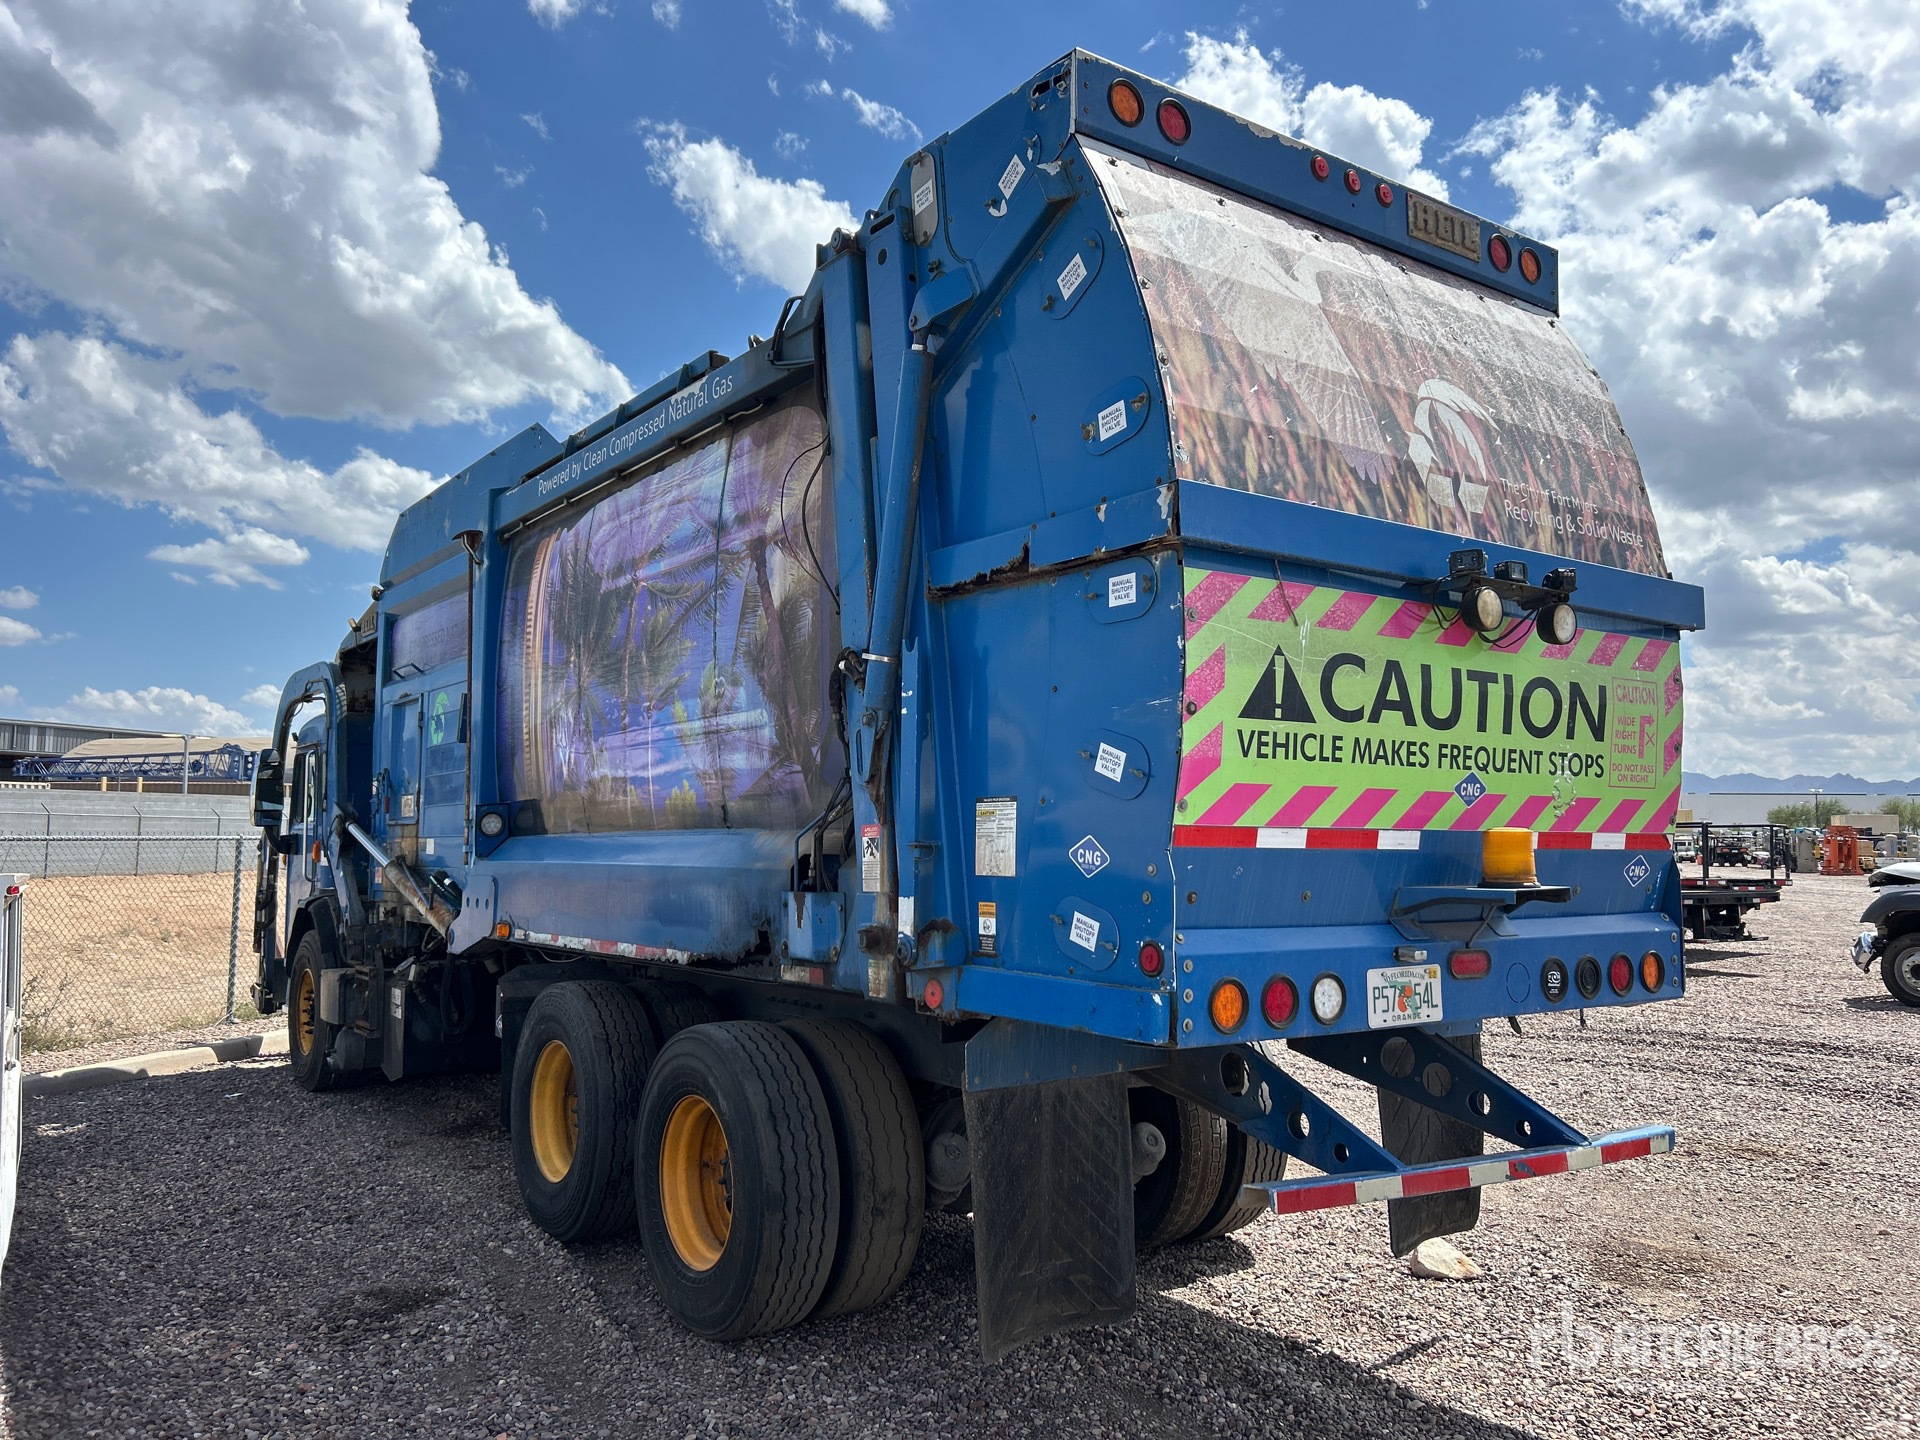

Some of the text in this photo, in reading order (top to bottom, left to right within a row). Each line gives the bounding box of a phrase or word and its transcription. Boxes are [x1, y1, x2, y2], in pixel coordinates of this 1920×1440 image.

[1060, 261, 1078, 283] MANUAL
[1062, 264, 1081, 289] SHUTOFF
[1067, 273, 1081, 290] VALVE
[1101, 406, 1122, 421] MANUAL
[1101, 412, 1123, 428] SHUTOFF
[1105, 420, 1121, 433] VALVE
[538, 375, 733, 497] Powered by Clean Compressed Natural Gas
[1500, 478, 1598, 514] The City of Fort Myers
[1504, 500, 1643, 547] Recycling & Solid Waste
[1111, 578, 1132, 588] MANUAL
[1111, 585, 1133, 594] SHUTOFF
[1114, 592, 1130, 600] VALVE
[1320, 653, 1607, 742] CAUTION
[1616, 684, 1656, 706] CAUTION
[1617, 716, 1635, 726] WIDE
[1615, 730, 1636, 740] RIGHT
[1102, 748, 1121, 761] MANUAL
[1237, 729, 1605, 778] VEHICLE MAKES FREQUENT STOPS
[1613, 744, 1636, 754] TURNS
[1100, 755, 1121, 768] SHUTOFF
[1101, 763, 1117, 774] VALVE
[1612, 763, 1654, 774] DO NOT PASS
[1617, 774, 1649, 783] ON RIGHT
[1460, 783, 1480, 797] CNG
[1077, 848, 1101, 866] CNG
[1629, 865, 1646, 877] CNG
[1076, 917, 1095, 931] MANUAL
[1074, 924, 1095, 938] SHUTOFF
[1075, 931, 1091, 944] VALVE
[1392, 1012, 1422, 1022] ORANGE
